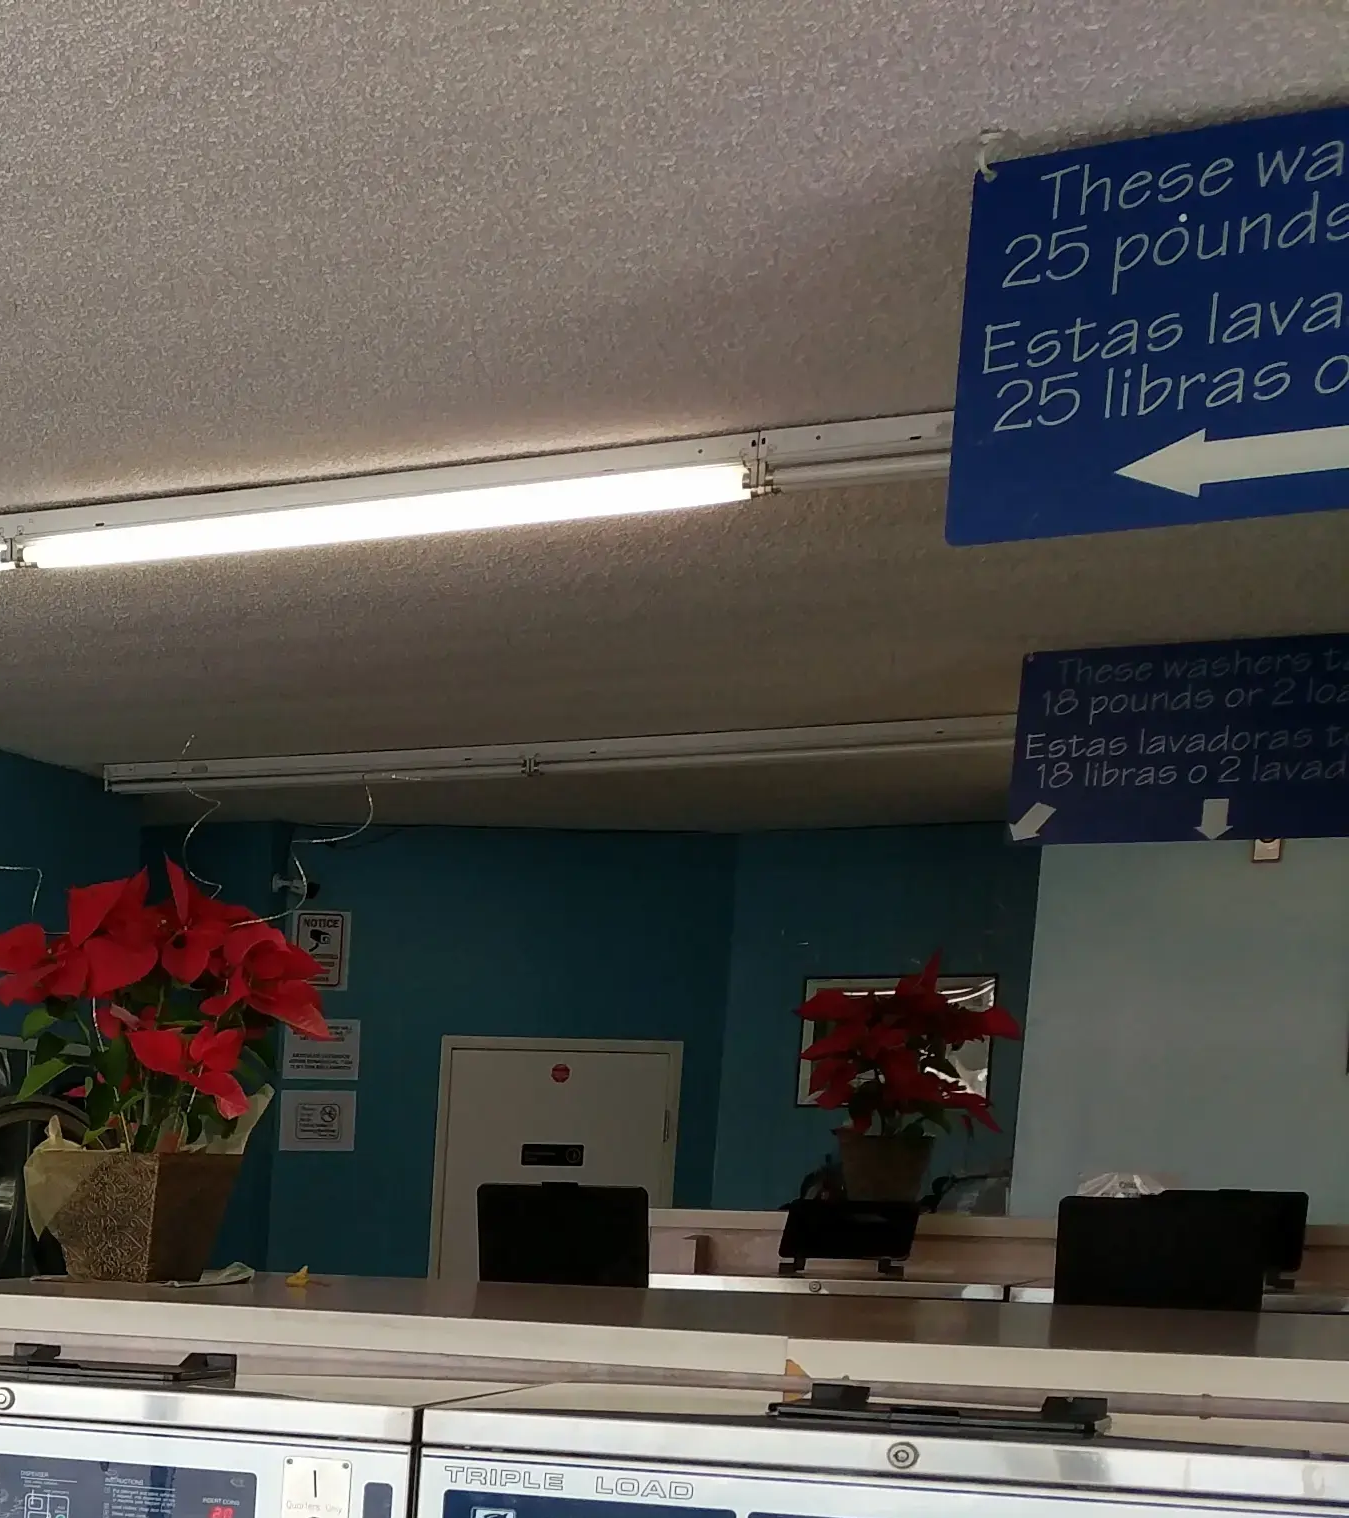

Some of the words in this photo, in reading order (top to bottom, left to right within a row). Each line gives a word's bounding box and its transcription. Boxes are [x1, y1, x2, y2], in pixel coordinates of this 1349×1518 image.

[1040, 157, 1236, 220] These
[1257, 139, 1346, 189] wa
[1002, 224, 1091, 289] 25
[1111, 190, 1349, 295] pounds
[982, 312, 1184, 375] Estas
[1209, 291, 1349, 345] lava
[993, 371, 1081, 432] 25
[1104, 361, 1292, 419] libras
[1314, 354, 1349, 395] o
[1057, 656, 1154, 687] These
[1163, 648, 1312, 681] washers
[1042, 688, 1080, 718] 18
[1088, 684, 1215, 726] pounds
[1225, 686, 1266, 710] or
[1271, 677, 1296, 707] 2
[1024, 732, 1128, 760] Estas
[1139, 725, 1313, 756] lavadoras
[1036, 761, 1075, 789] 18
[1084, 755, 1179, 788] libras
[1188, 764, 1209, 784] o
[1218, 756, 1242, 784] 2
[303, 918, 340, 928] NOTICE
[444, 1465, 565, 1491] TRIPLE
[595, 1476, 695, 1500] LOAD
